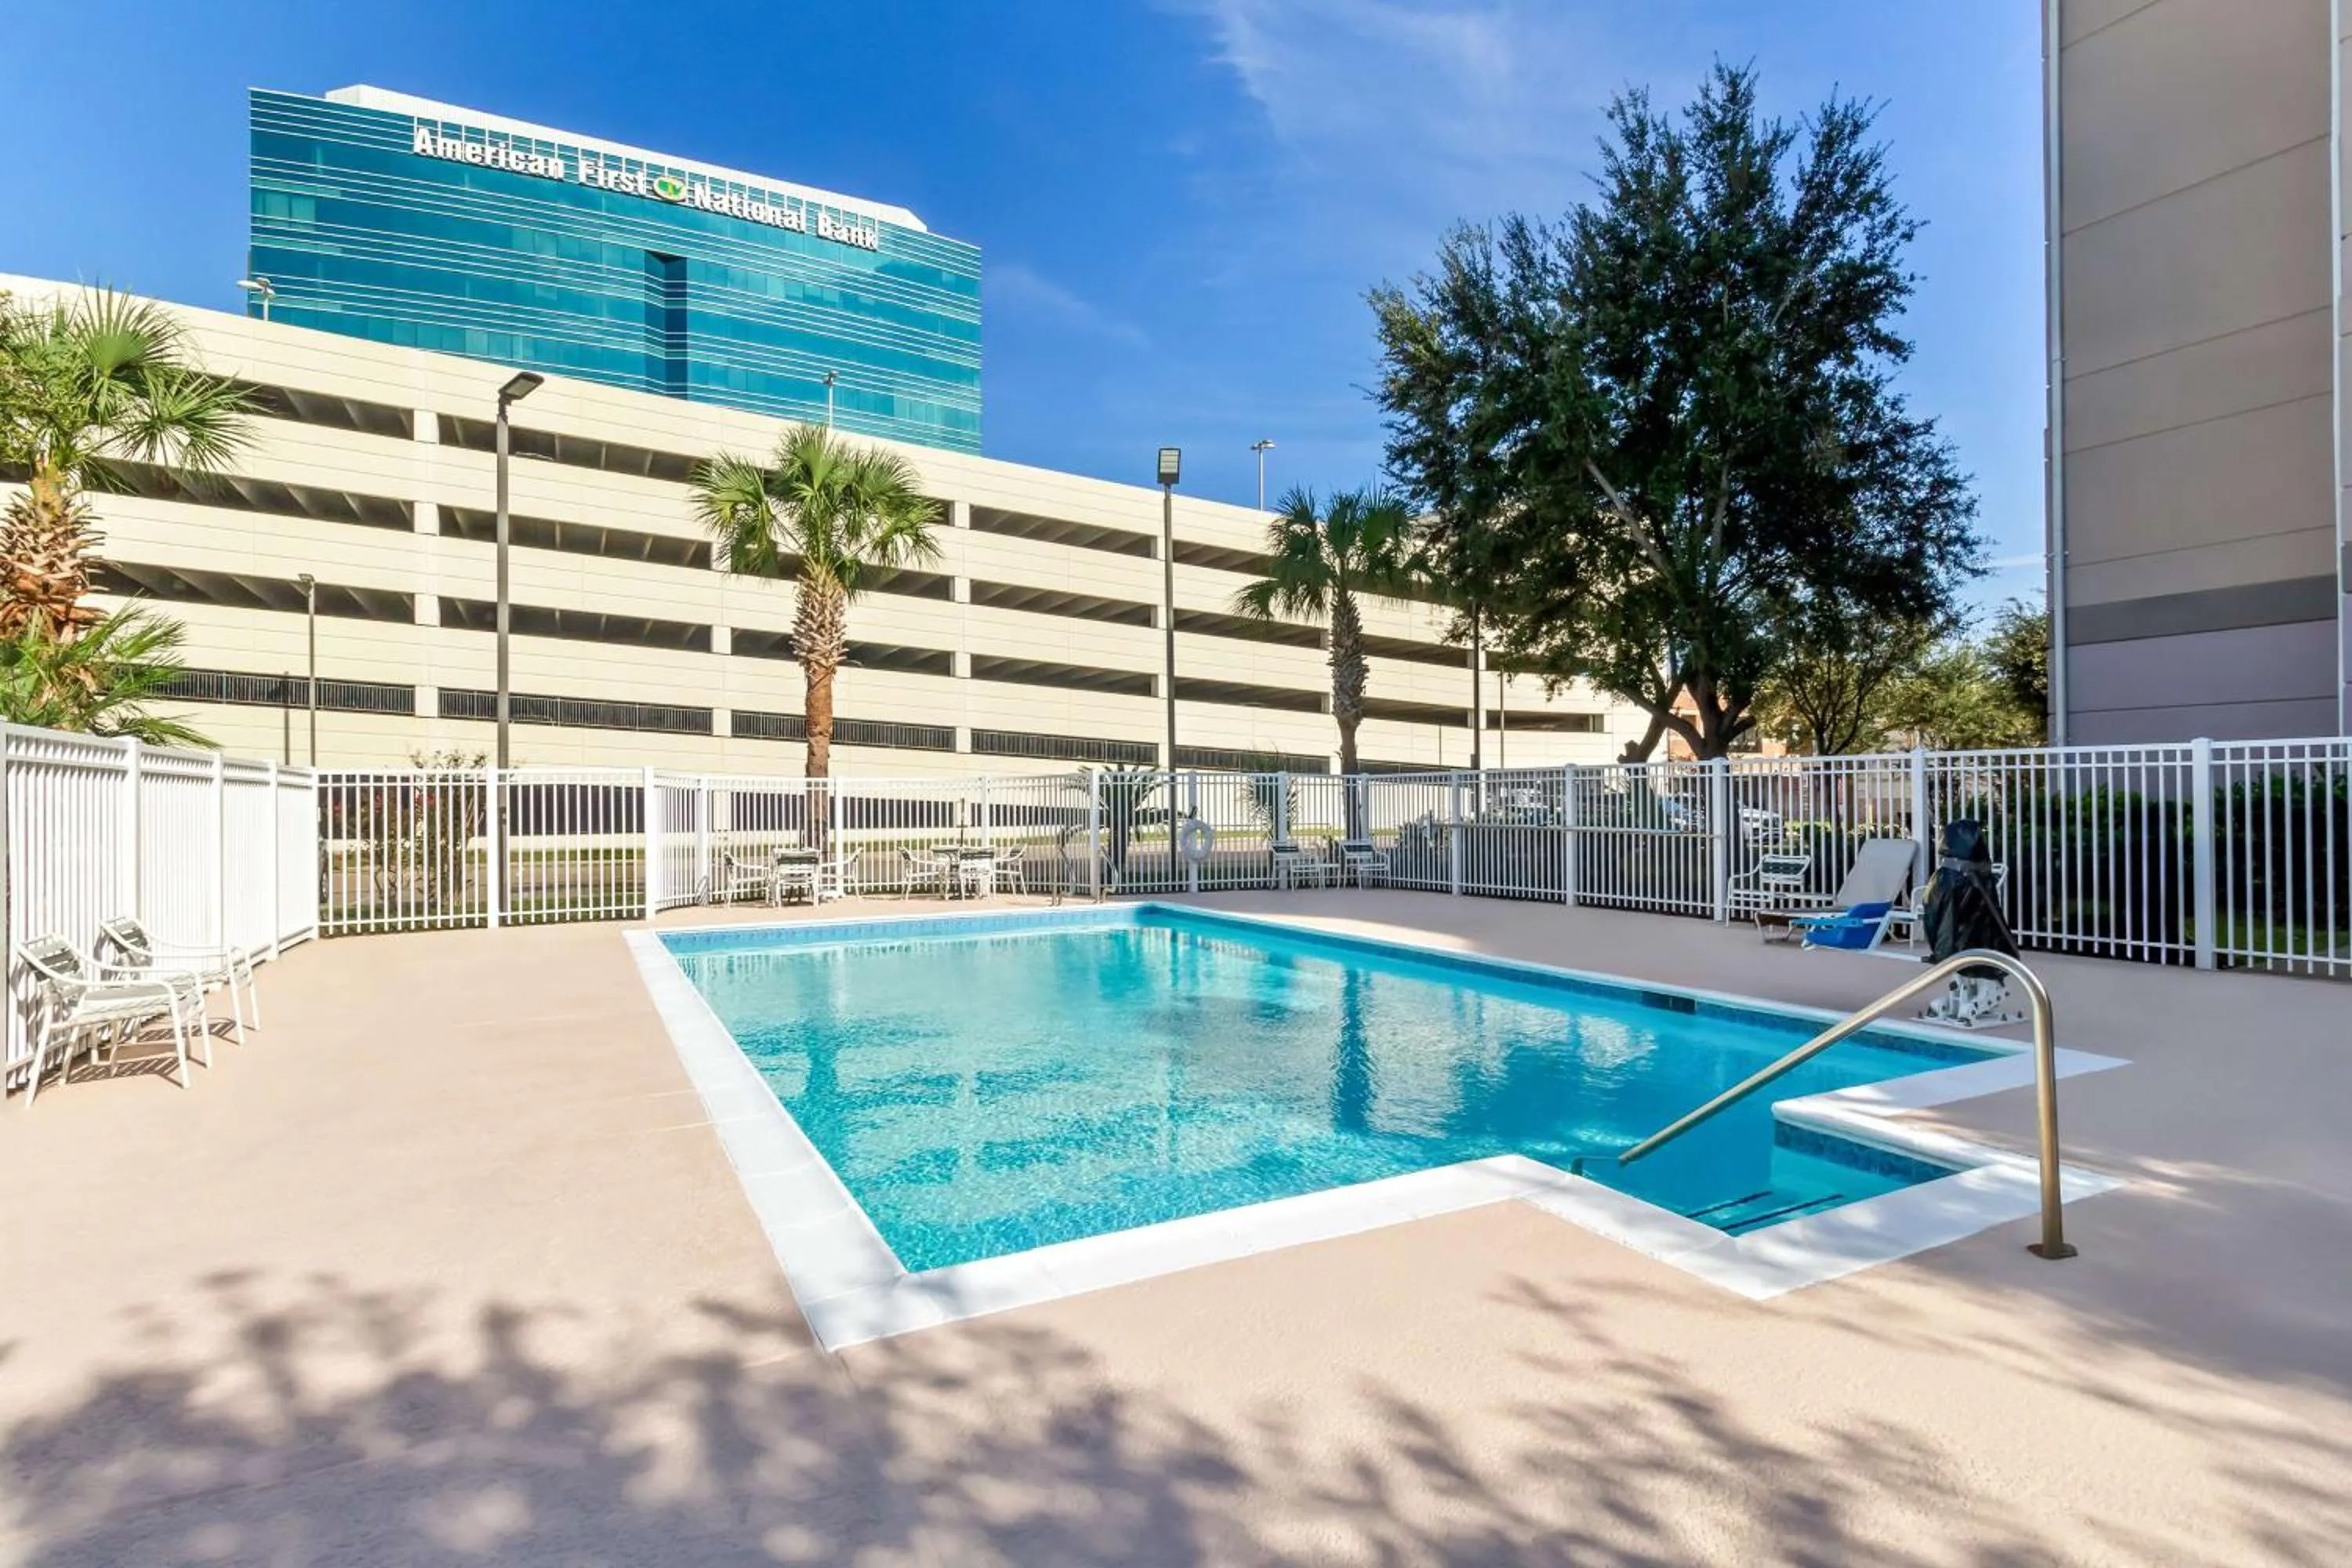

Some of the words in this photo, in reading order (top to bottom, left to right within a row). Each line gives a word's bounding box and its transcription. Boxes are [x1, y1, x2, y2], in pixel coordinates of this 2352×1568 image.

[414, 128, 564, 180] American
[579, 159, 646, 194] First
[695, 183, 805, 232] National
[818, 212, 878, 249] Bank
